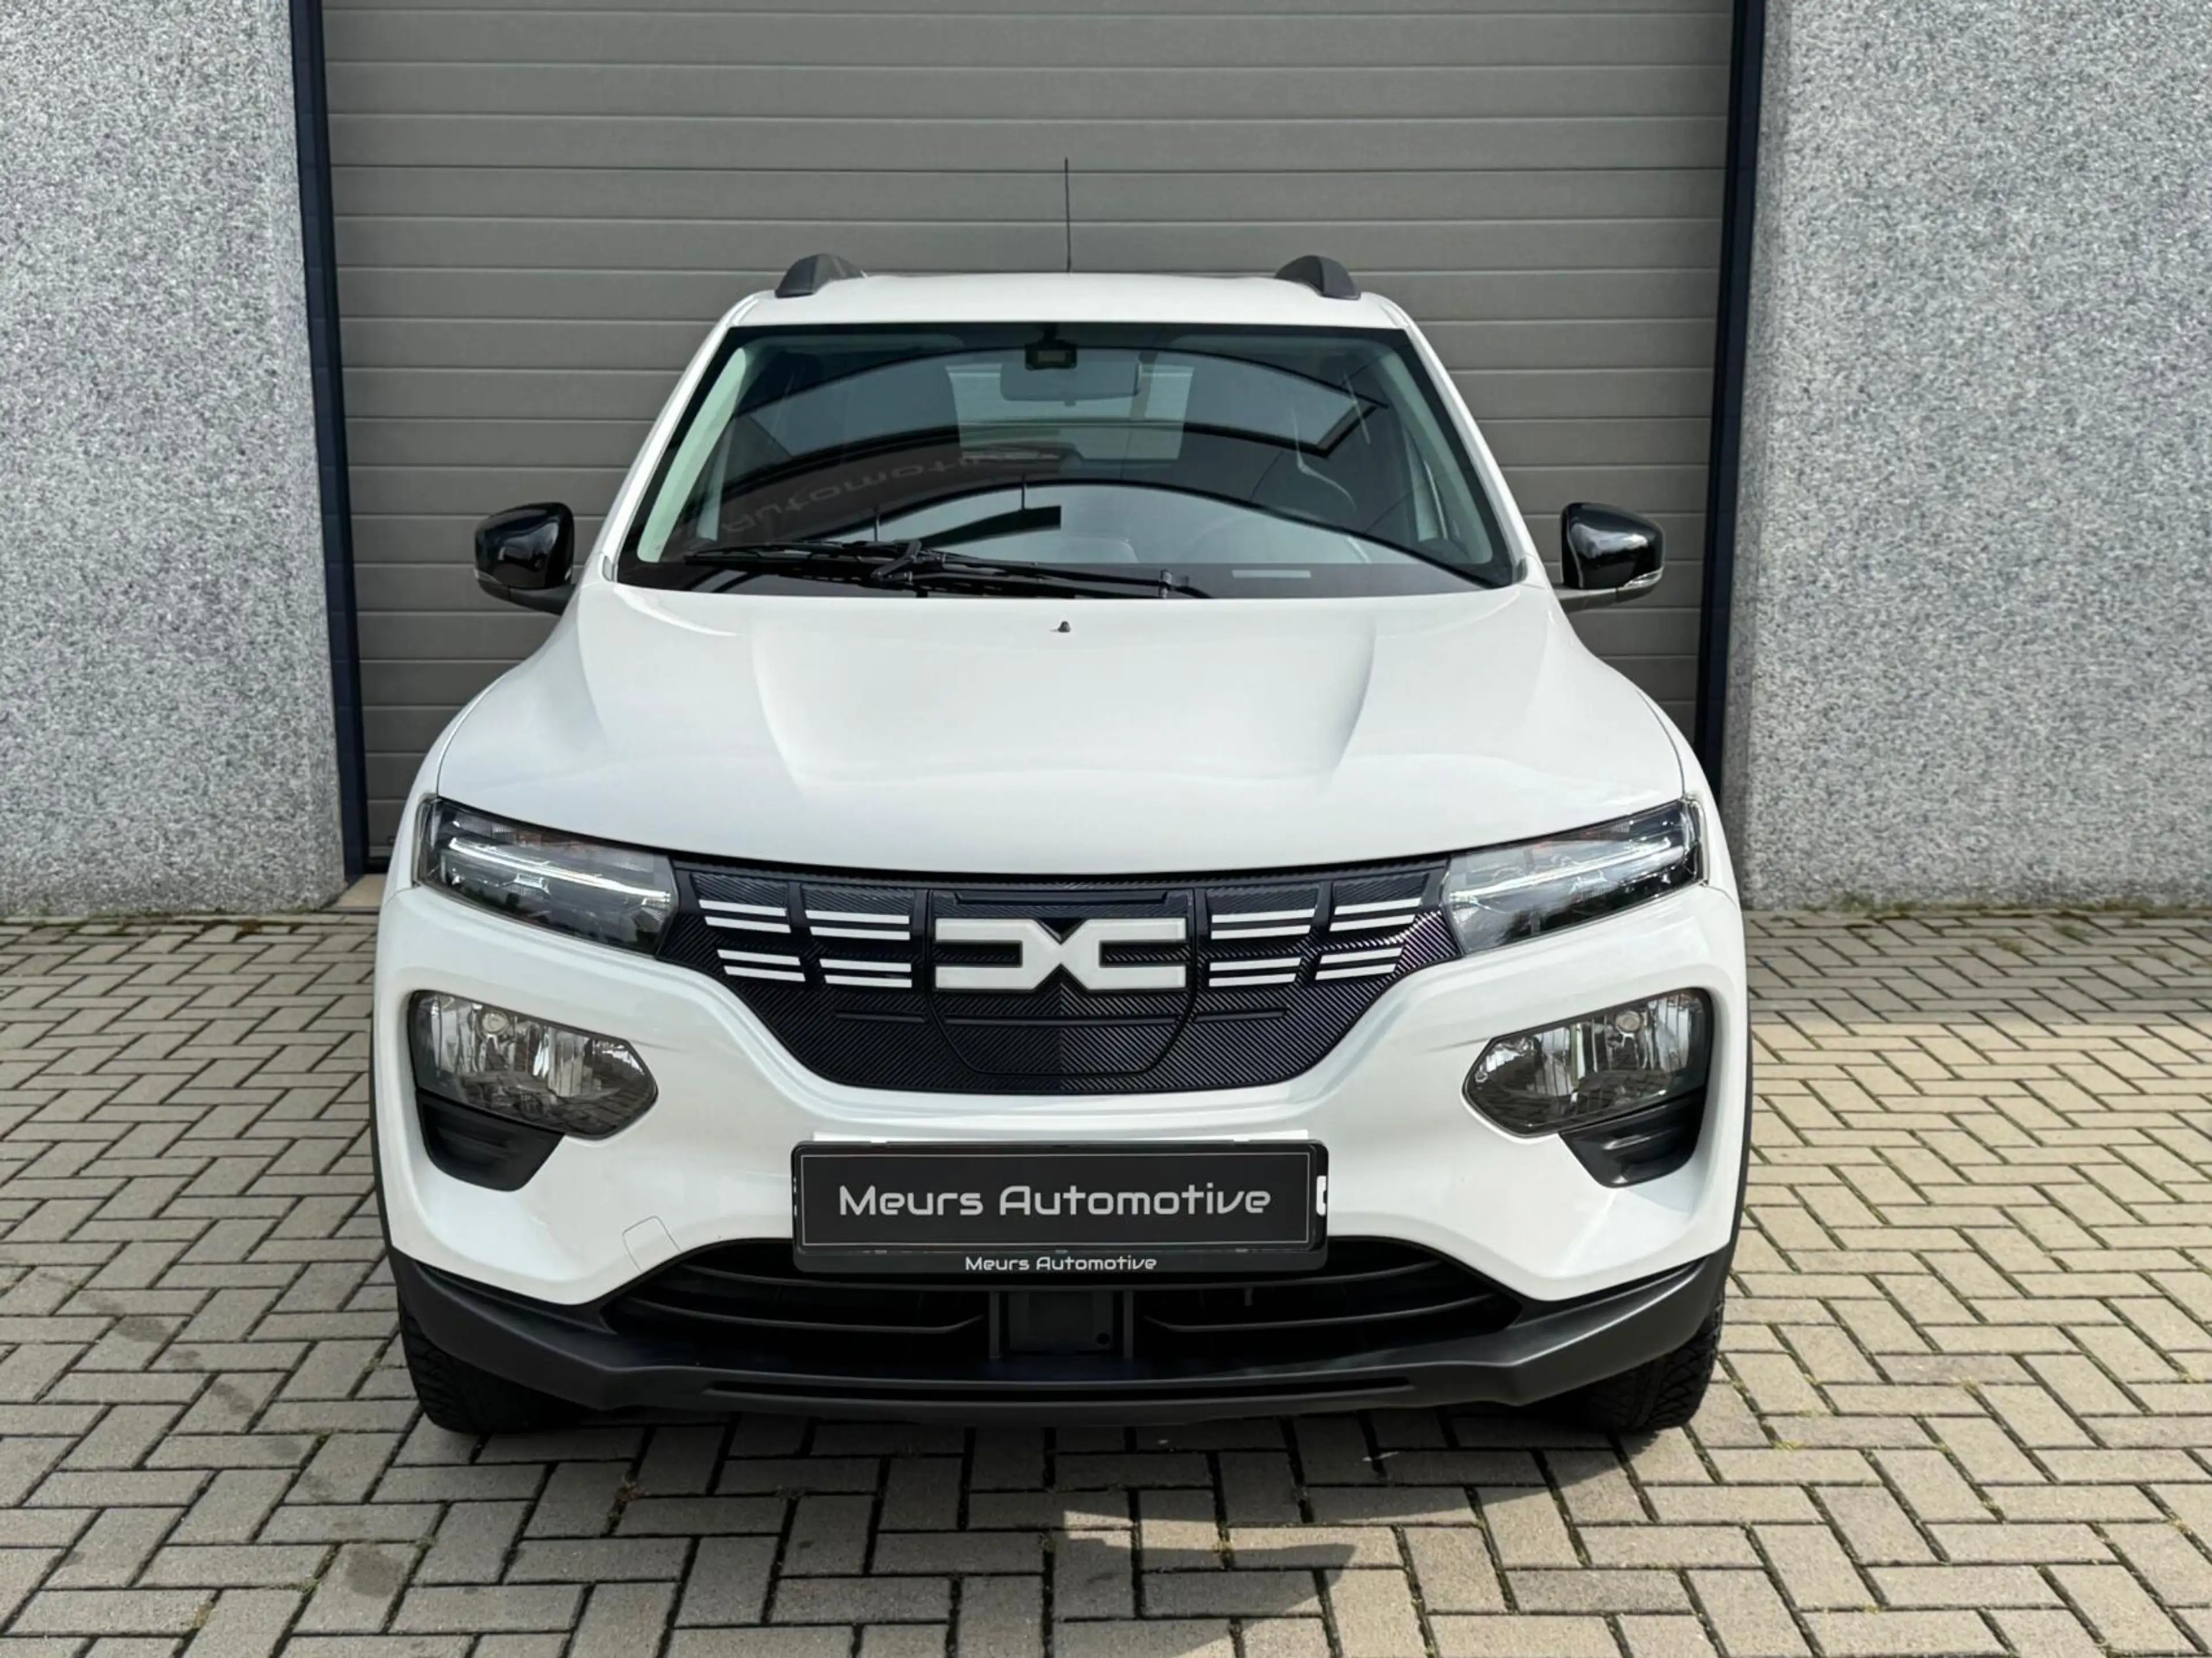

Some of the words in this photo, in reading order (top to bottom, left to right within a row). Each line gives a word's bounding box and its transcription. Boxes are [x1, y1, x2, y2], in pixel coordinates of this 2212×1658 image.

[839, 1185, 983, 1216] Meurs
[999, 1182, 1271, 1216] Automotive
[965, 1256, 1030, 1271] Meurs
[1036, 1255, 1157, 1270] Automotive
